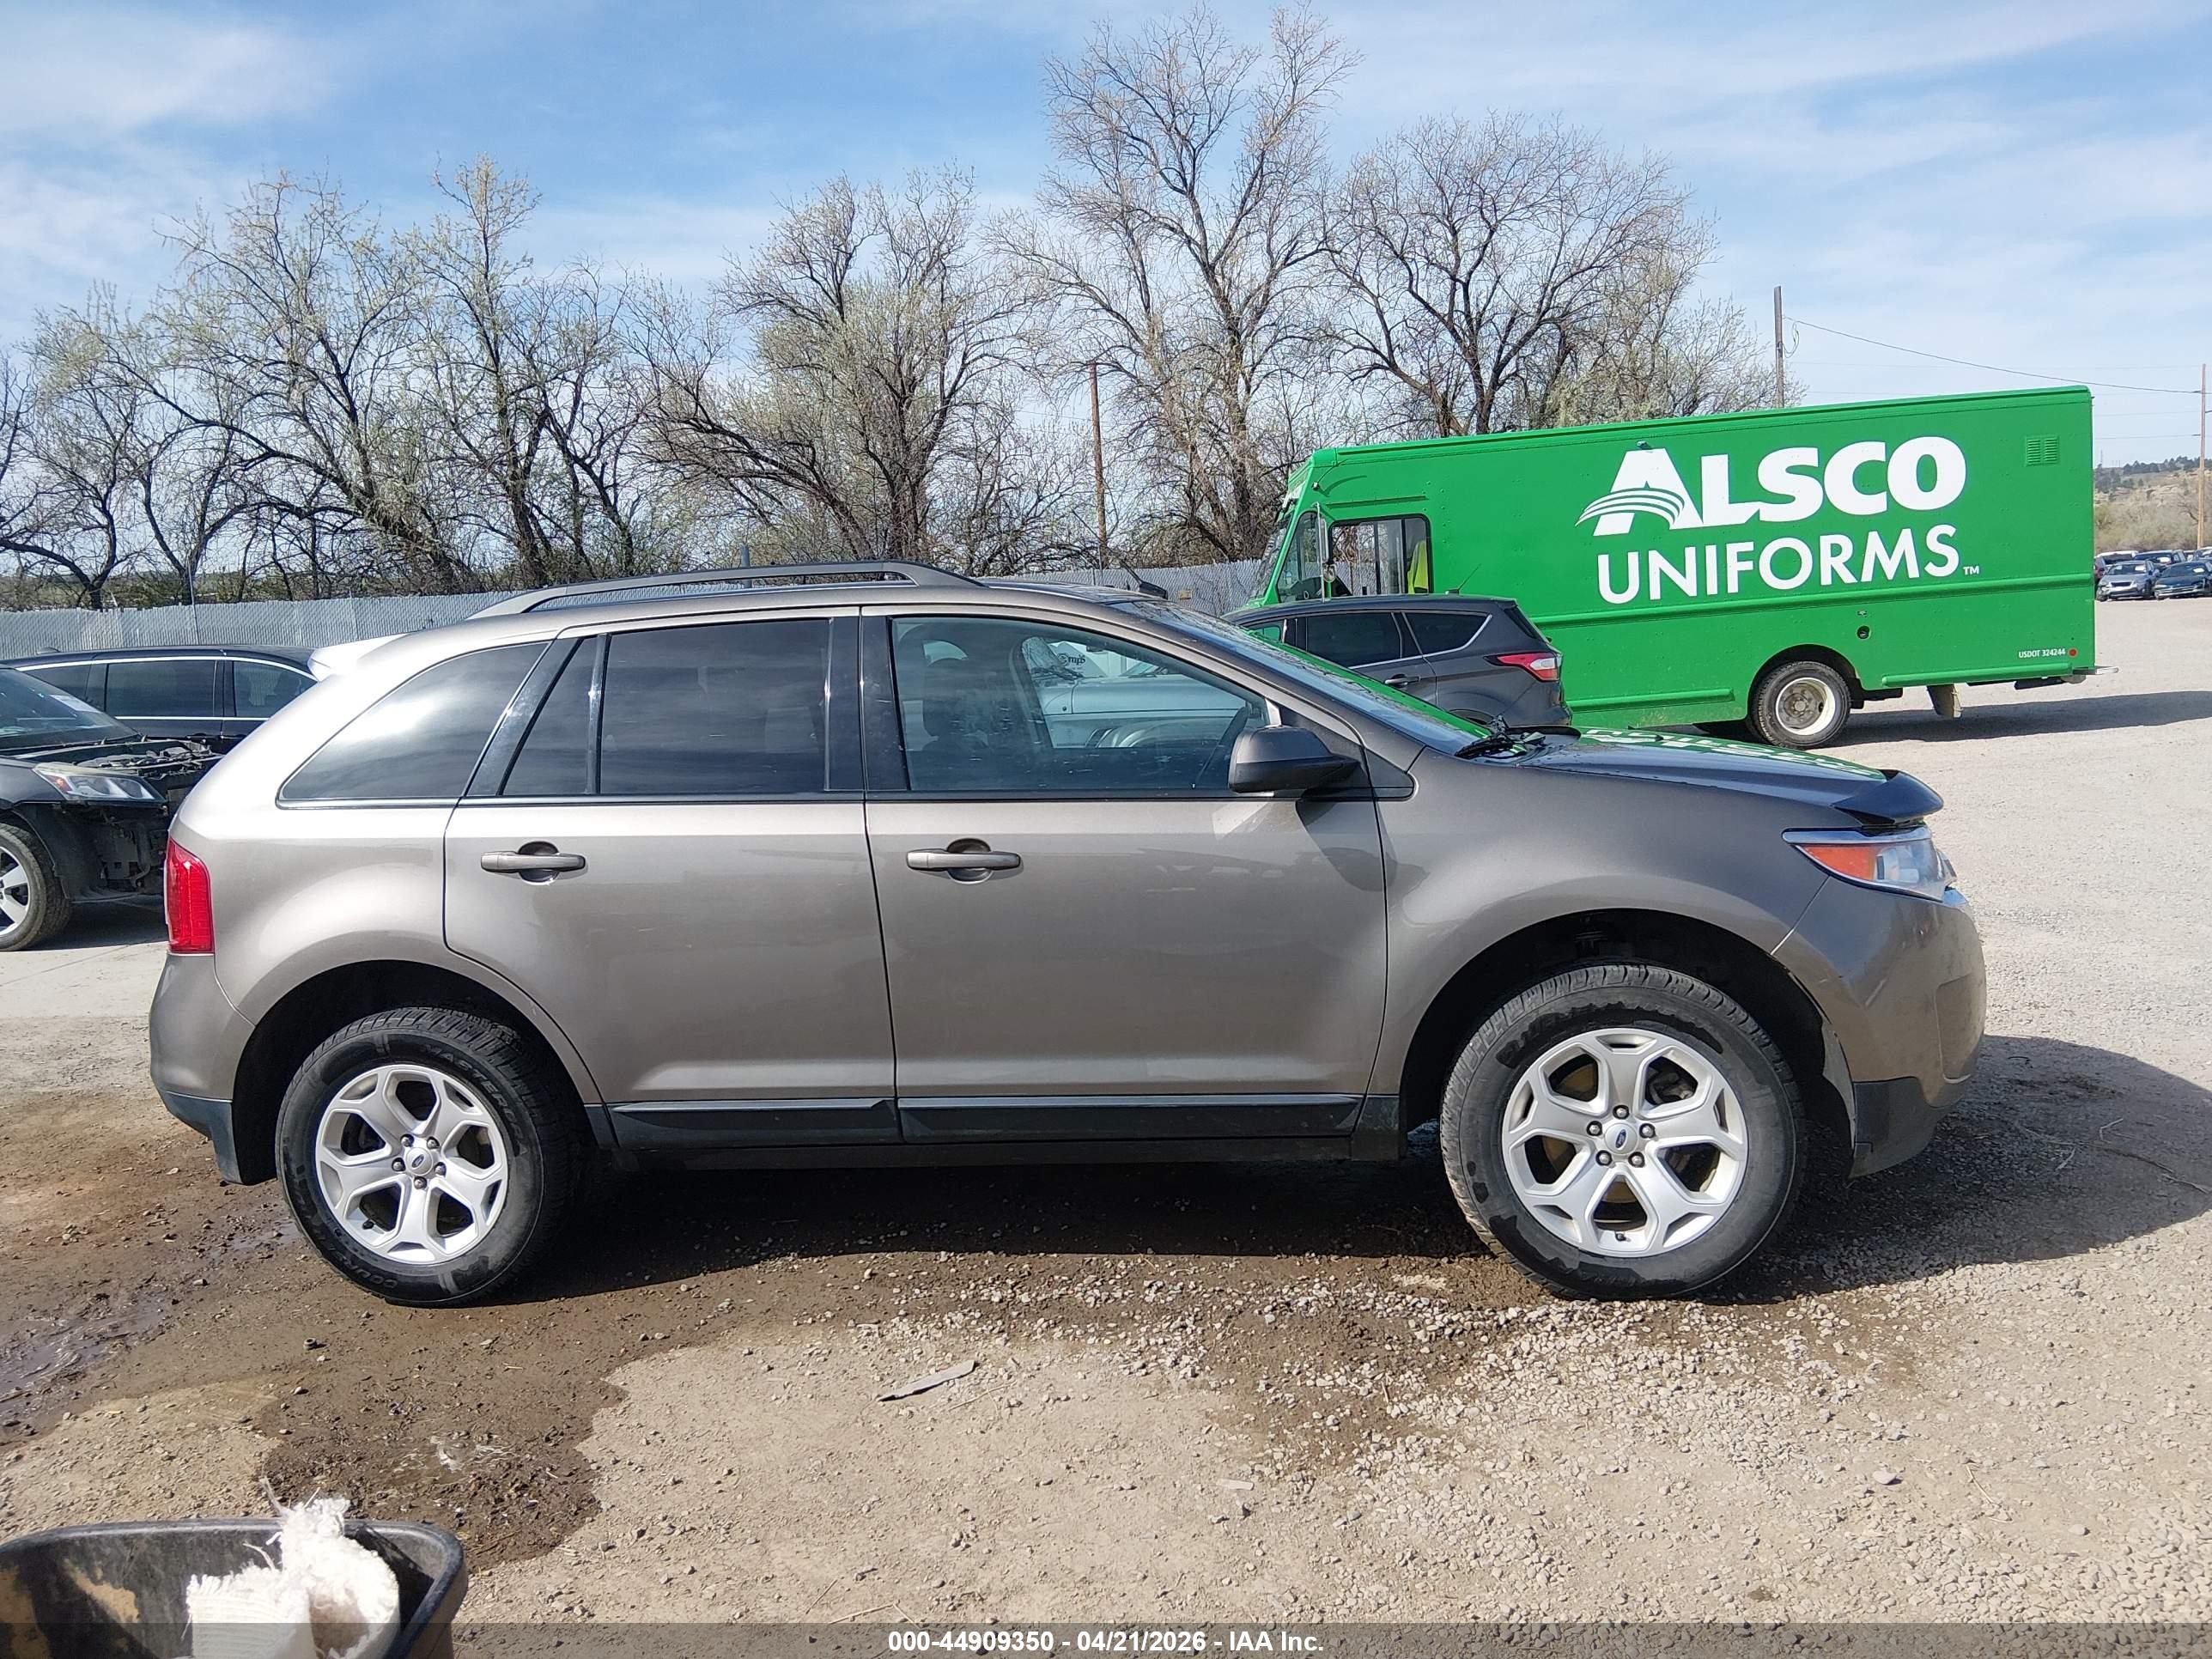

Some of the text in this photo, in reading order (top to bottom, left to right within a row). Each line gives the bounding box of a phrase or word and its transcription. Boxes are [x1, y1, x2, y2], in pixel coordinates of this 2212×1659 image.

[1575, 436, 1966, 537] ALSCO
[1597, 524, 1960, 604] UNIFORMS
[2018, 647, 2066, 659] USDOT 324244
